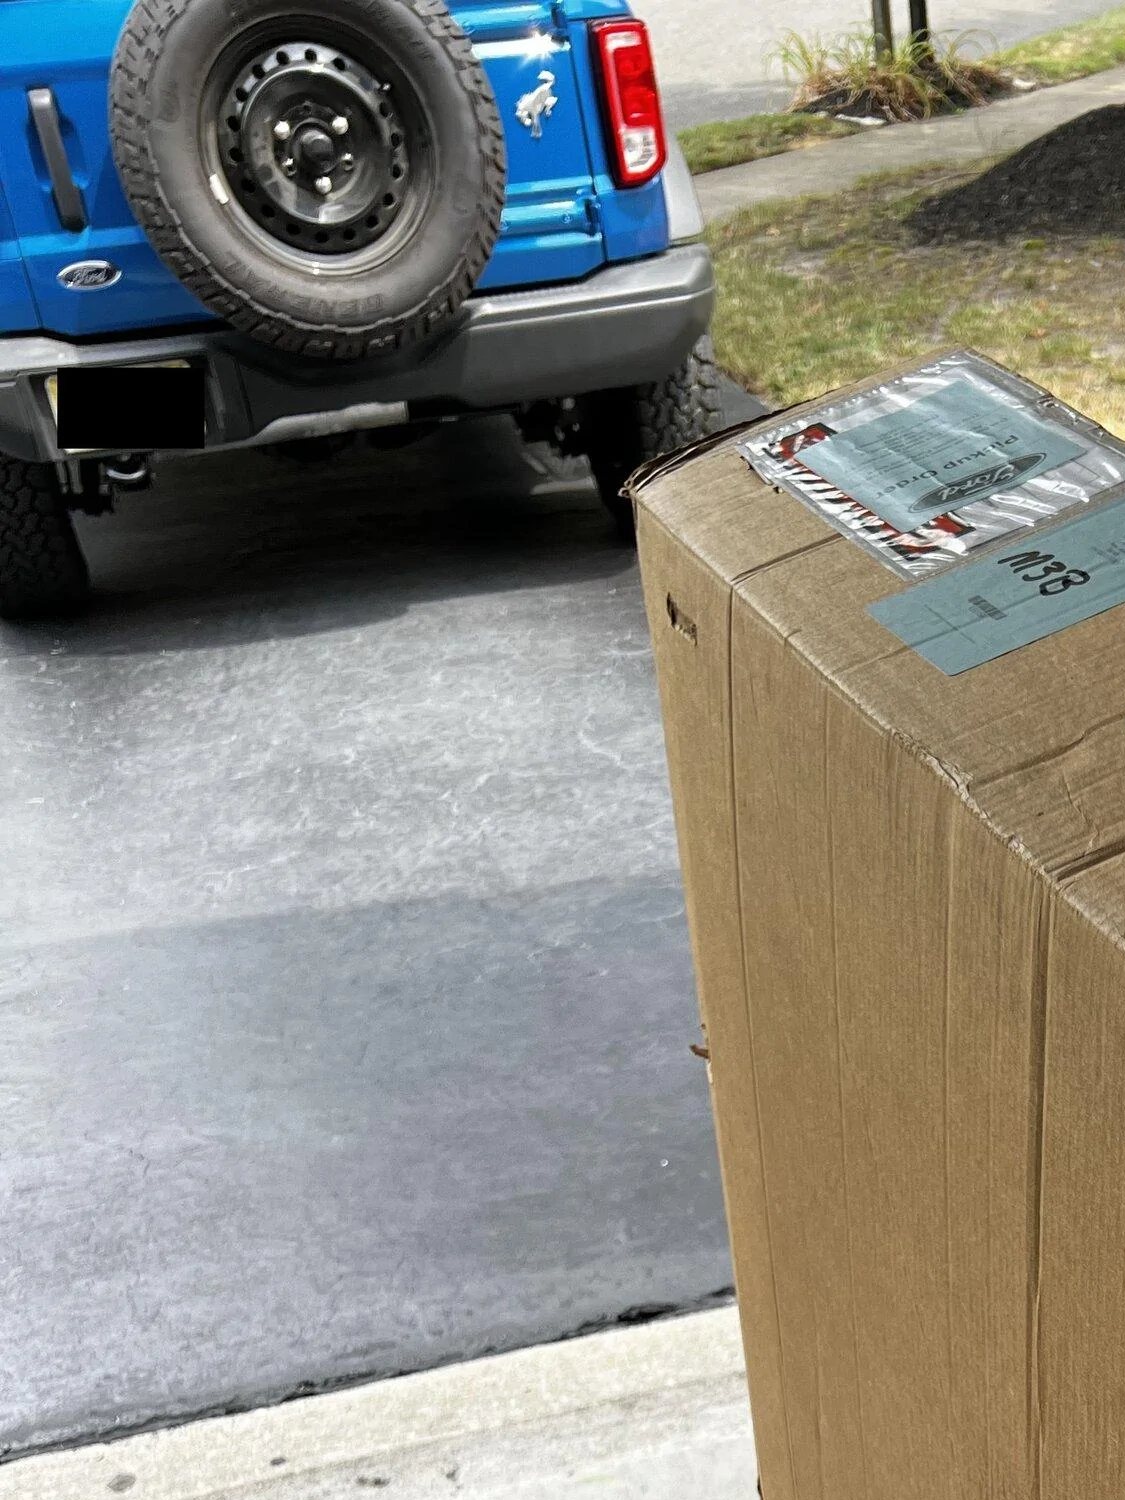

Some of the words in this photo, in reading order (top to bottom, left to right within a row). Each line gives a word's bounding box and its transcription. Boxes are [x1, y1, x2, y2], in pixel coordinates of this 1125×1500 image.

[939, 433, 1021, 470] Pickup
[870, 468, 939, 500] Order
[935, 463, 1015, 501] Ford
